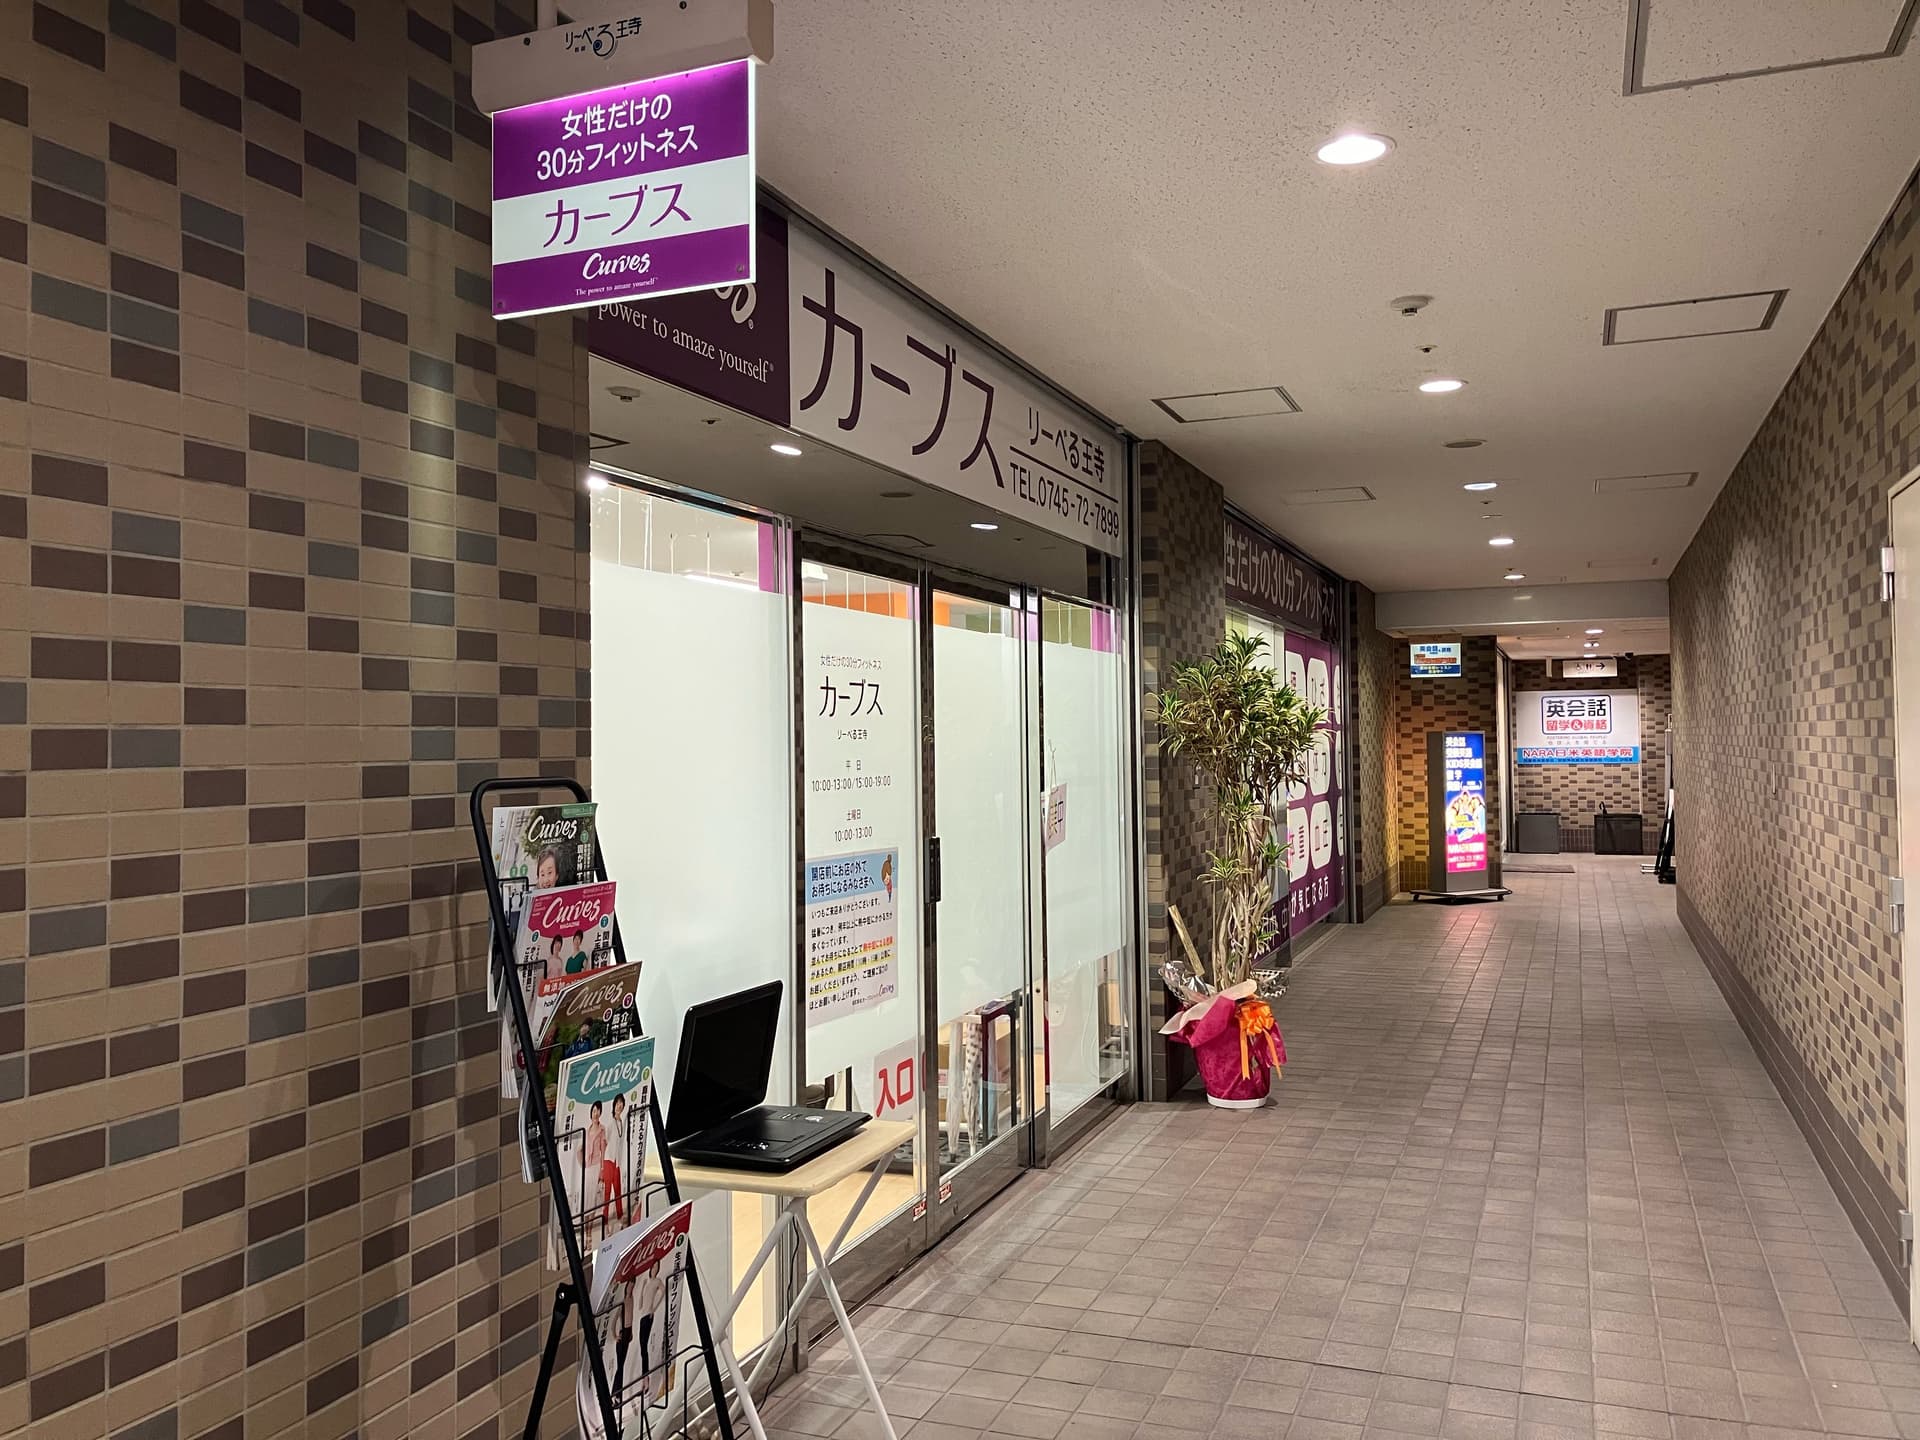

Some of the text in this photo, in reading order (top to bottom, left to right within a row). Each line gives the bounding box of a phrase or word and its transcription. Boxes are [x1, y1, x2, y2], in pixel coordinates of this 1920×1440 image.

[561, 93, 672, 141] 女性だけの
[537, 124, 698, 181] 30分フィットネス
[543, 183, 692, 248] カーブス
[582, 253, 651, 280] Curves
[575, 288, 586, 297] The
[653, 317, 668, 339] to
[672, 328, 716, 360] amaze
[799, 267, 1005, 489] カーブス
[1009, 461, 1120, 539] TEL.0745-72-7899
[819, 675, 883, 718] カーブス
[1546, 699, 1607, 718] 英会話
[527, 815, 577, 843] Curves
[542, 896, 600, 929] Curves
[566, 980, 624, 1017] Curves
[581, 1058, 641, 1096] Curves
[876, 1057, 914, 1118] 入口
[621, 1225, 676, 1276] Curves
